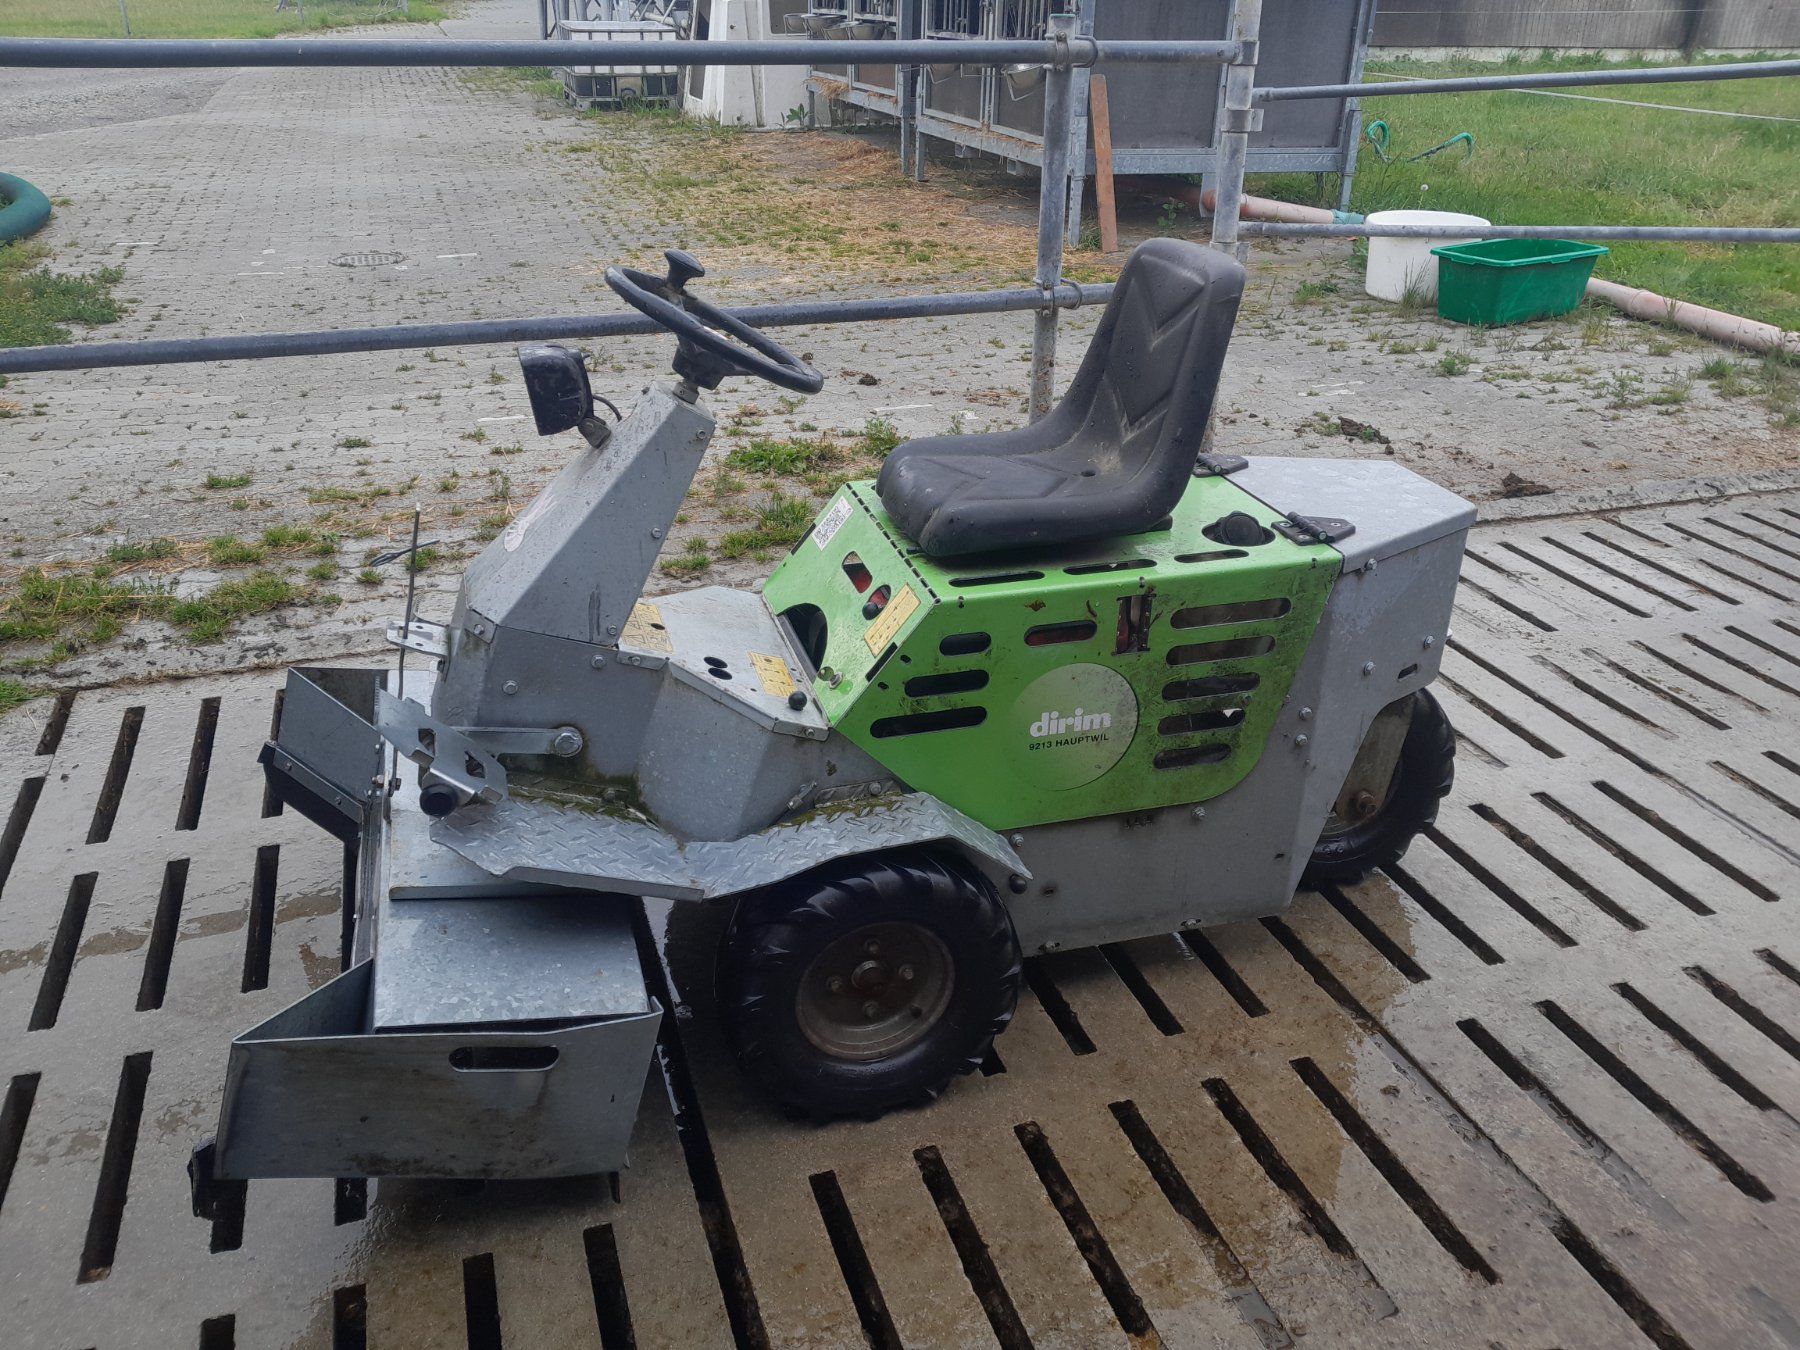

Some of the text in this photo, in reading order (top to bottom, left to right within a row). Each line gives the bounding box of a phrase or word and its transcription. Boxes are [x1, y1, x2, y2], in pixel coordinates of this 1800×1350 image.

[1029, 707, 1111, 737] dirim
[1029, 733, 1109, 751] 9213 HAUPTWIL
